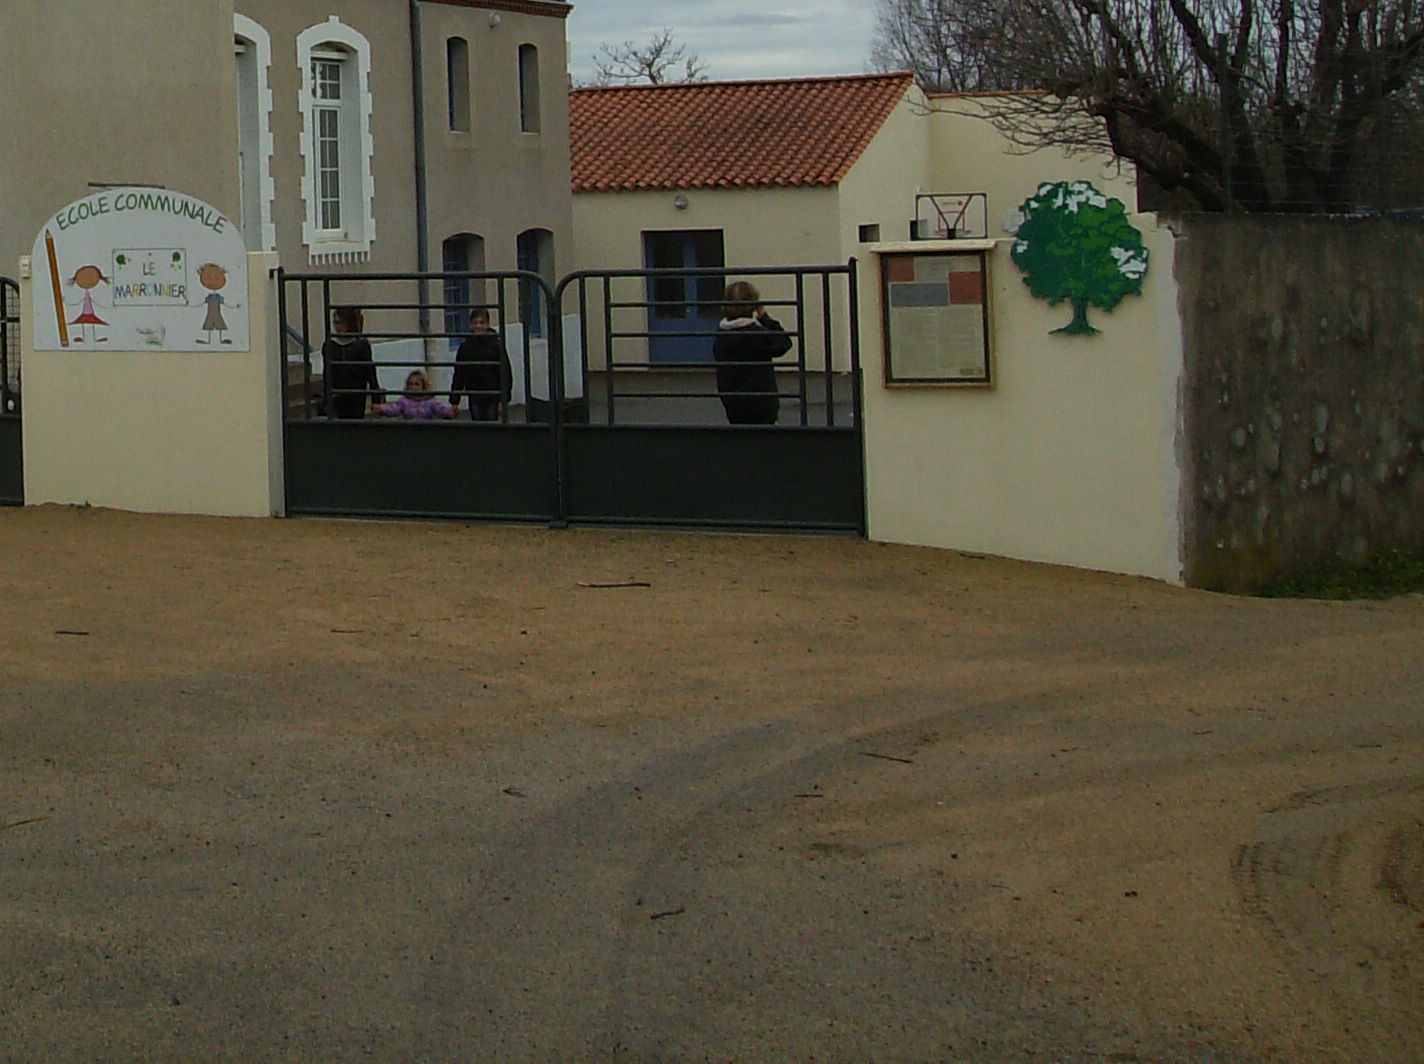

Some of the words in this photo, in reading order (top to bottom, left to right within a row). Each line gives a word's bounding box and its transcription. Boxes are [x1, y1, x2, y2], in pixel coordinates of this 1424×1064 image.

[56, 197, 110, 231] ECOLE
[114, 193, 227, 234] COMMUNALE
[143, 262, 156, 276] LE
[114, 282, 186, 299] MARRONNIER
